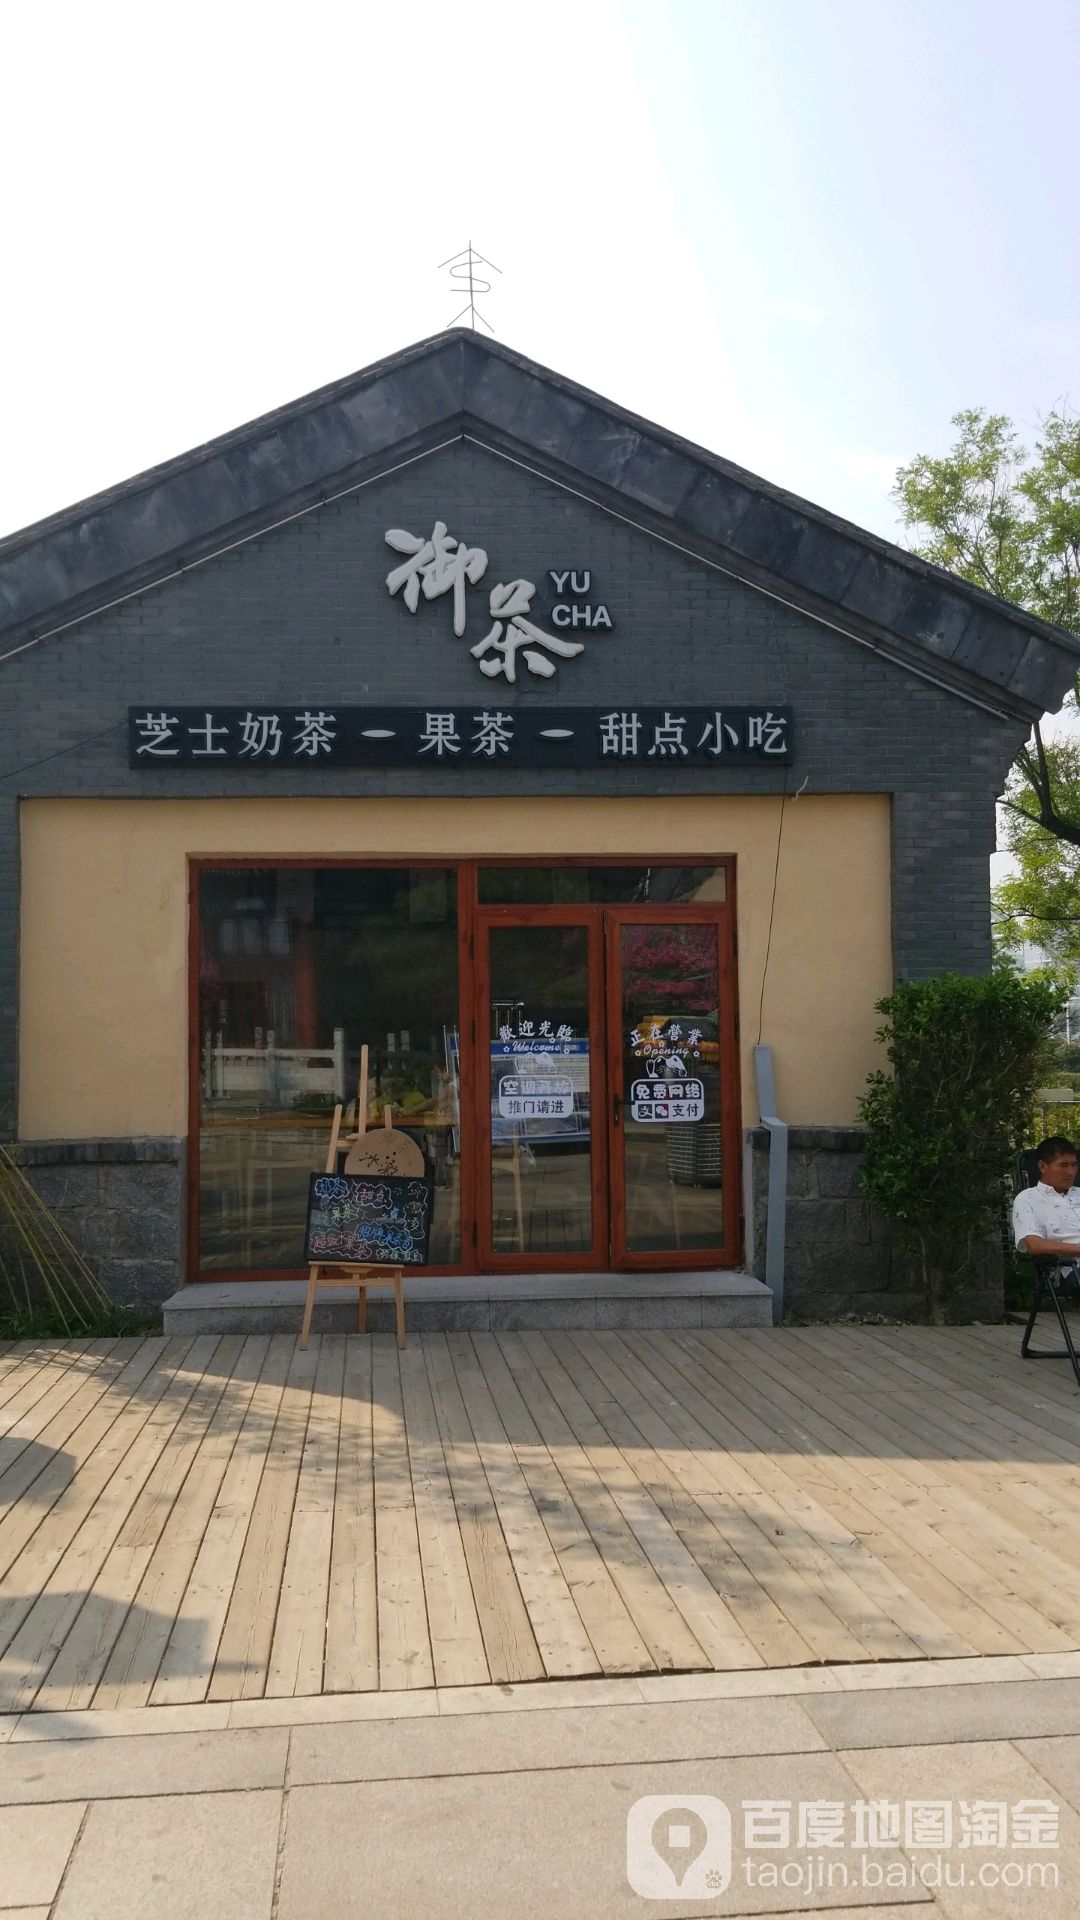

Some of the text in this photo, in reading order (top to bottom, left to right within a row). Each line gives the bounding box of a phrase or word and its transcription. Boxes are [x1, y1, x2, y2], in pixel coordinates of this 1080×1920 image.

[550, 571, 591, 593] YU
[385, 521, 585, 684] 御茶
[552, 605, 613, 627] CHA
[512, 1041, 561, 1051] Welcome
[643, 1045, 689, 1058] Opening
[636, 1084, 700, 1099] 免费网络
[508, 1100, 564, 1114] 推门请进
